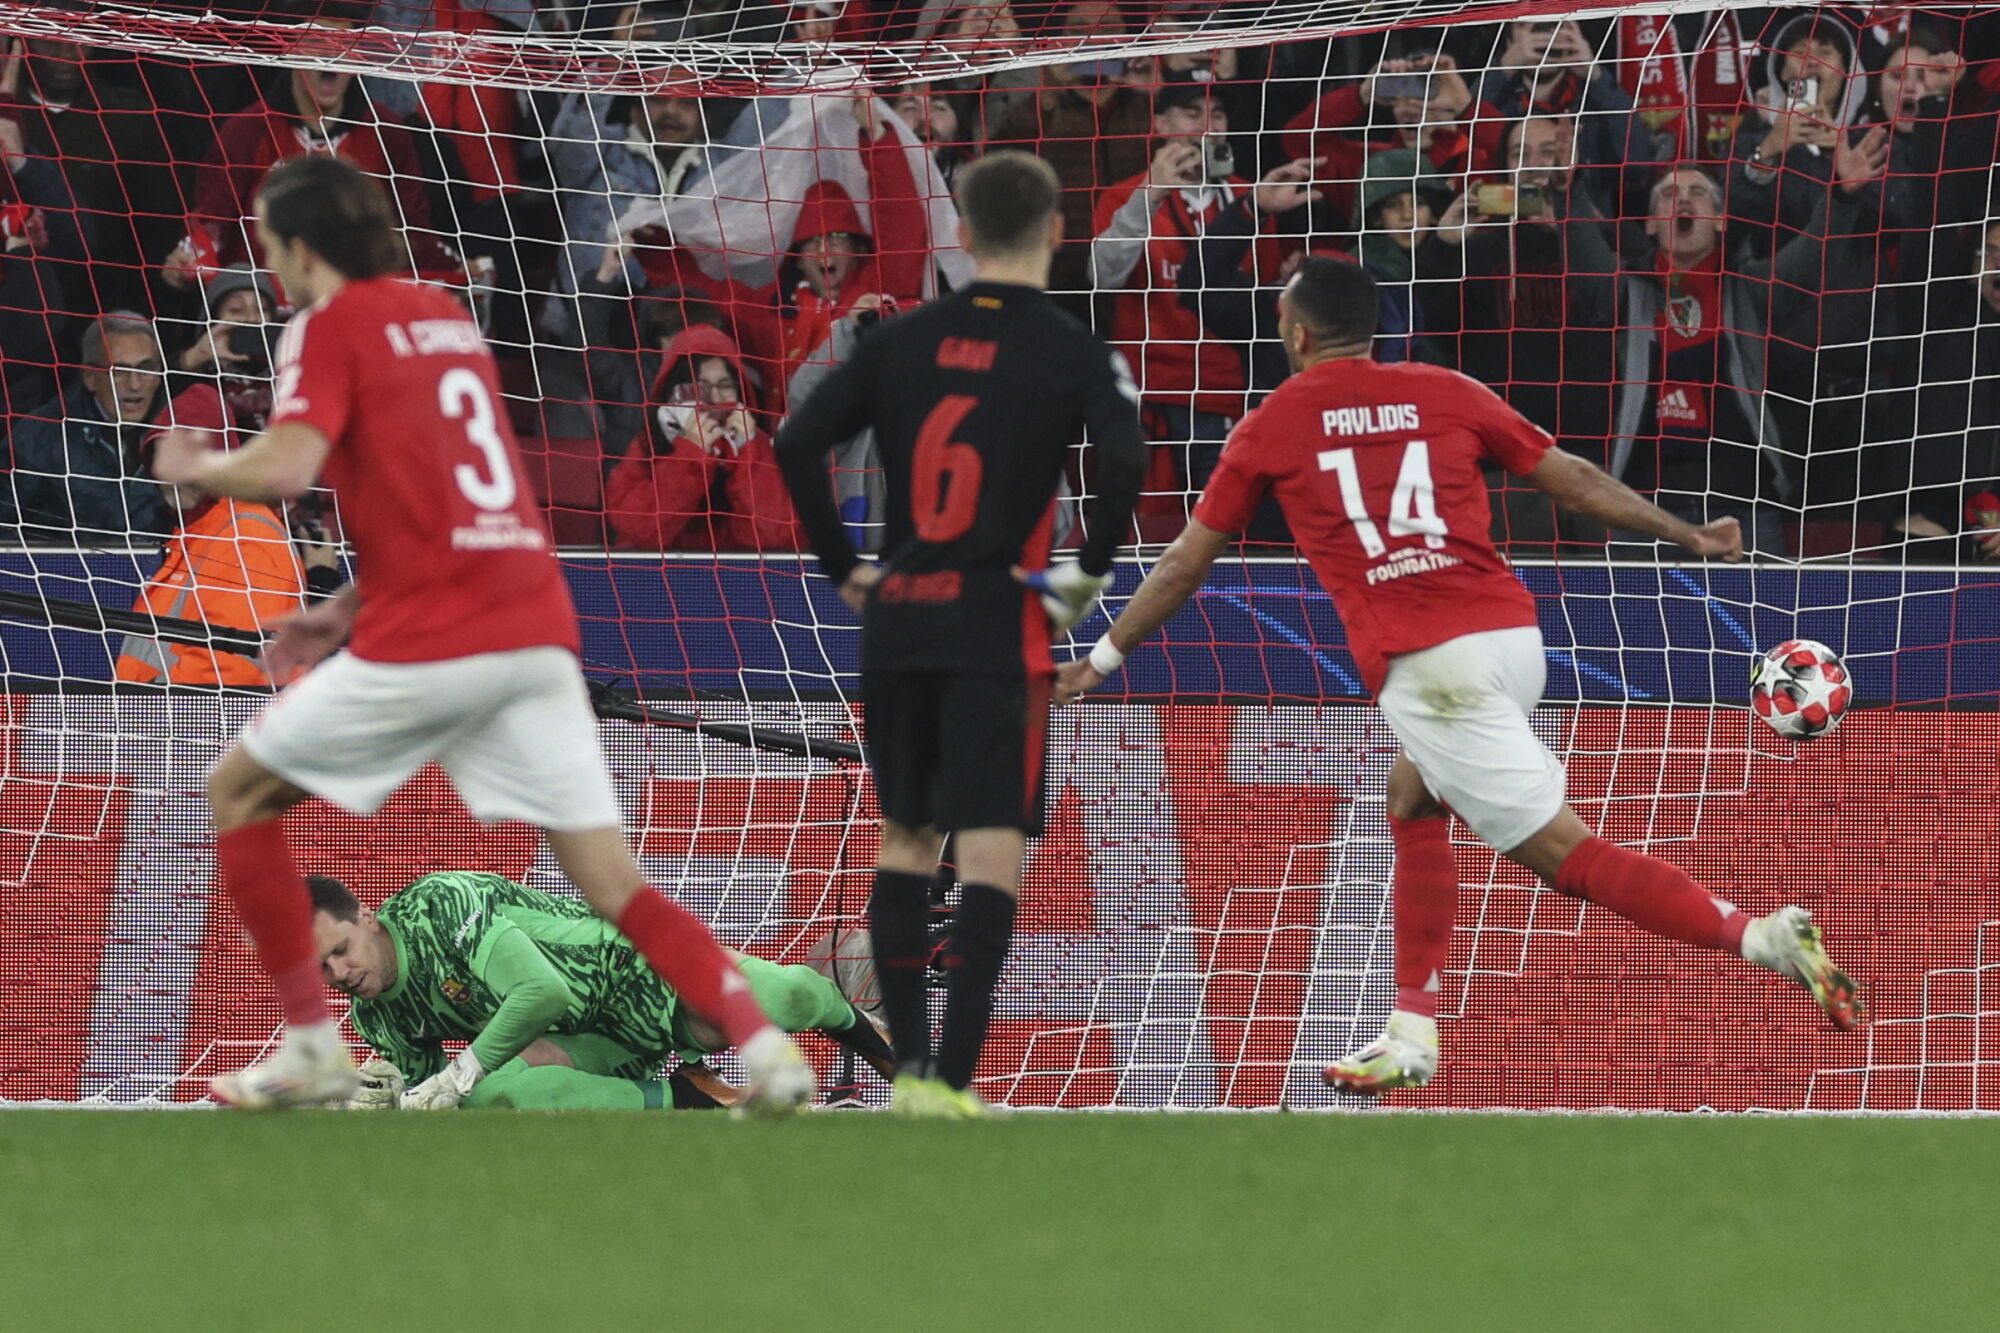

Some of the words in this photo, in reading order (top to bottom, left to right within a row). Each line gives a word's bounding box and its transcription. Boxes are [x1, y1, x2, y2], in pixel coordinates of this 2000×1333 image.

[439, 367, 516, 512] 3
[910, 393, 984, 543] 6
[1321, 404, 1420, 437] PAVLIDIS
[1316, 440, 1449, 559] 14
